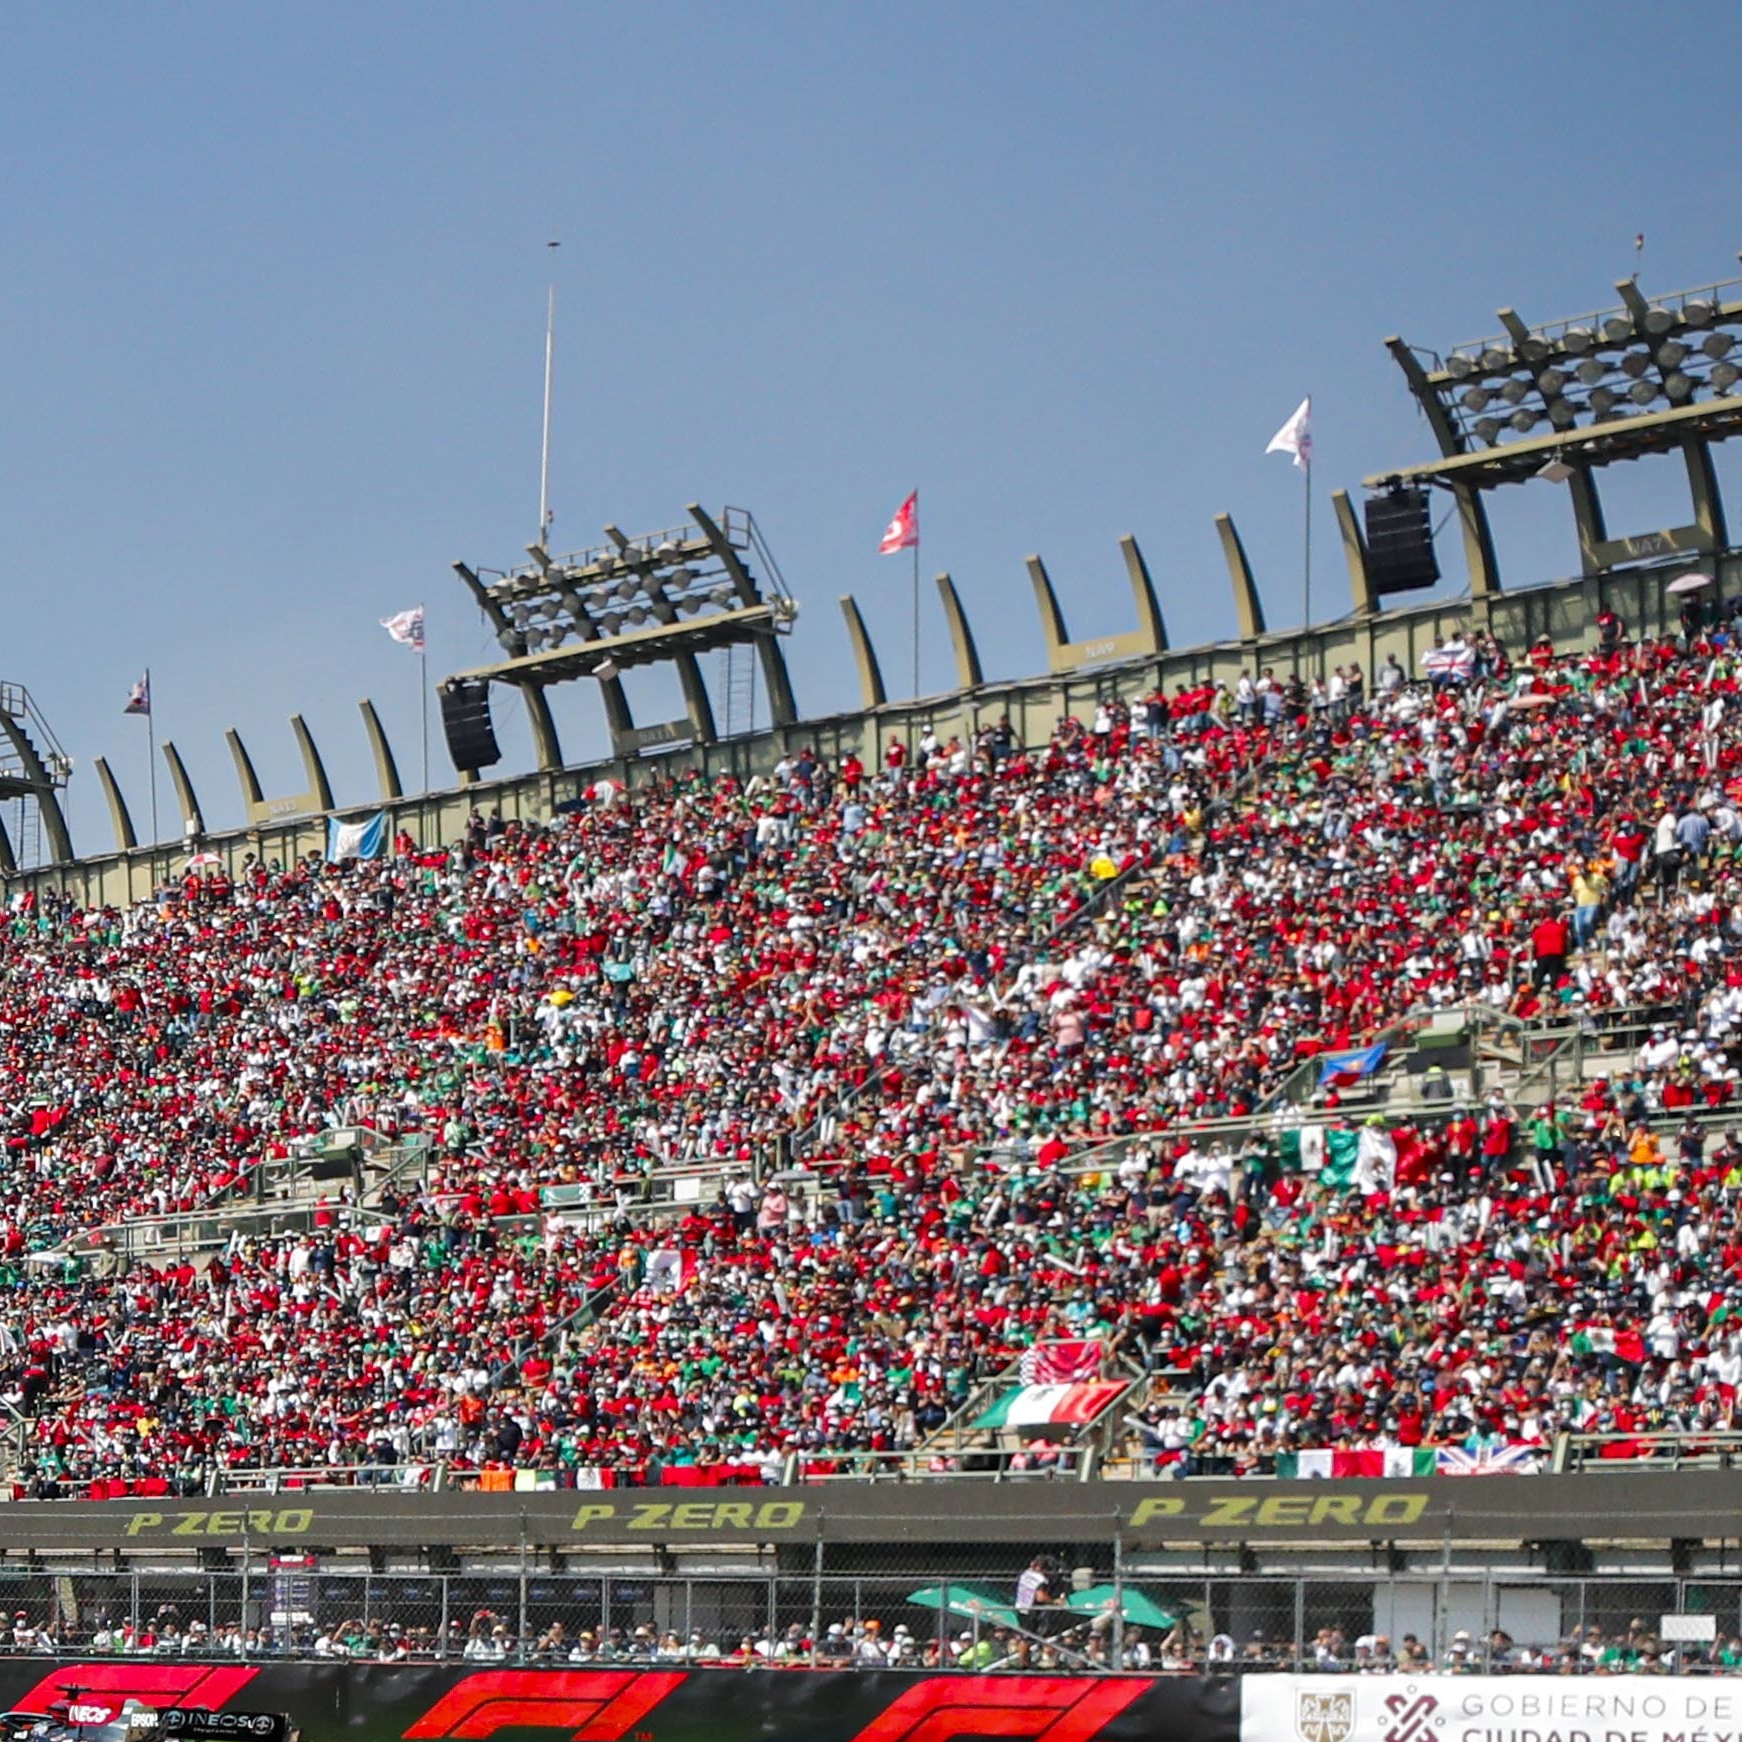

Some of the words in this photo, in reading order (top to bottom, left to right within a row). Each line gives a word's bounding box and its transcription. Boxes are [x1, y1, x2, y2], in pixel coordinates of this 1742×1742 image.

[126, 1512, 163, 1536] P
[171, 1508, 315, 1536] ZERO
[571, 1504, 615, 1530] P
[627, 1502, 806, 1530] ZERO
[1129, 1496, 1186, 1527] P
[1200, 1493, 1430, 1527] ZERO
[69, 1705, 111, 1723] INEOS
[188, 1713, 249, 1727] INEOS
[402, 1670, 690, 1742] F1
[1462, 1694, 1666, 1719] GOBIERNO
[1686, 1696, 1733, 1719] DE
